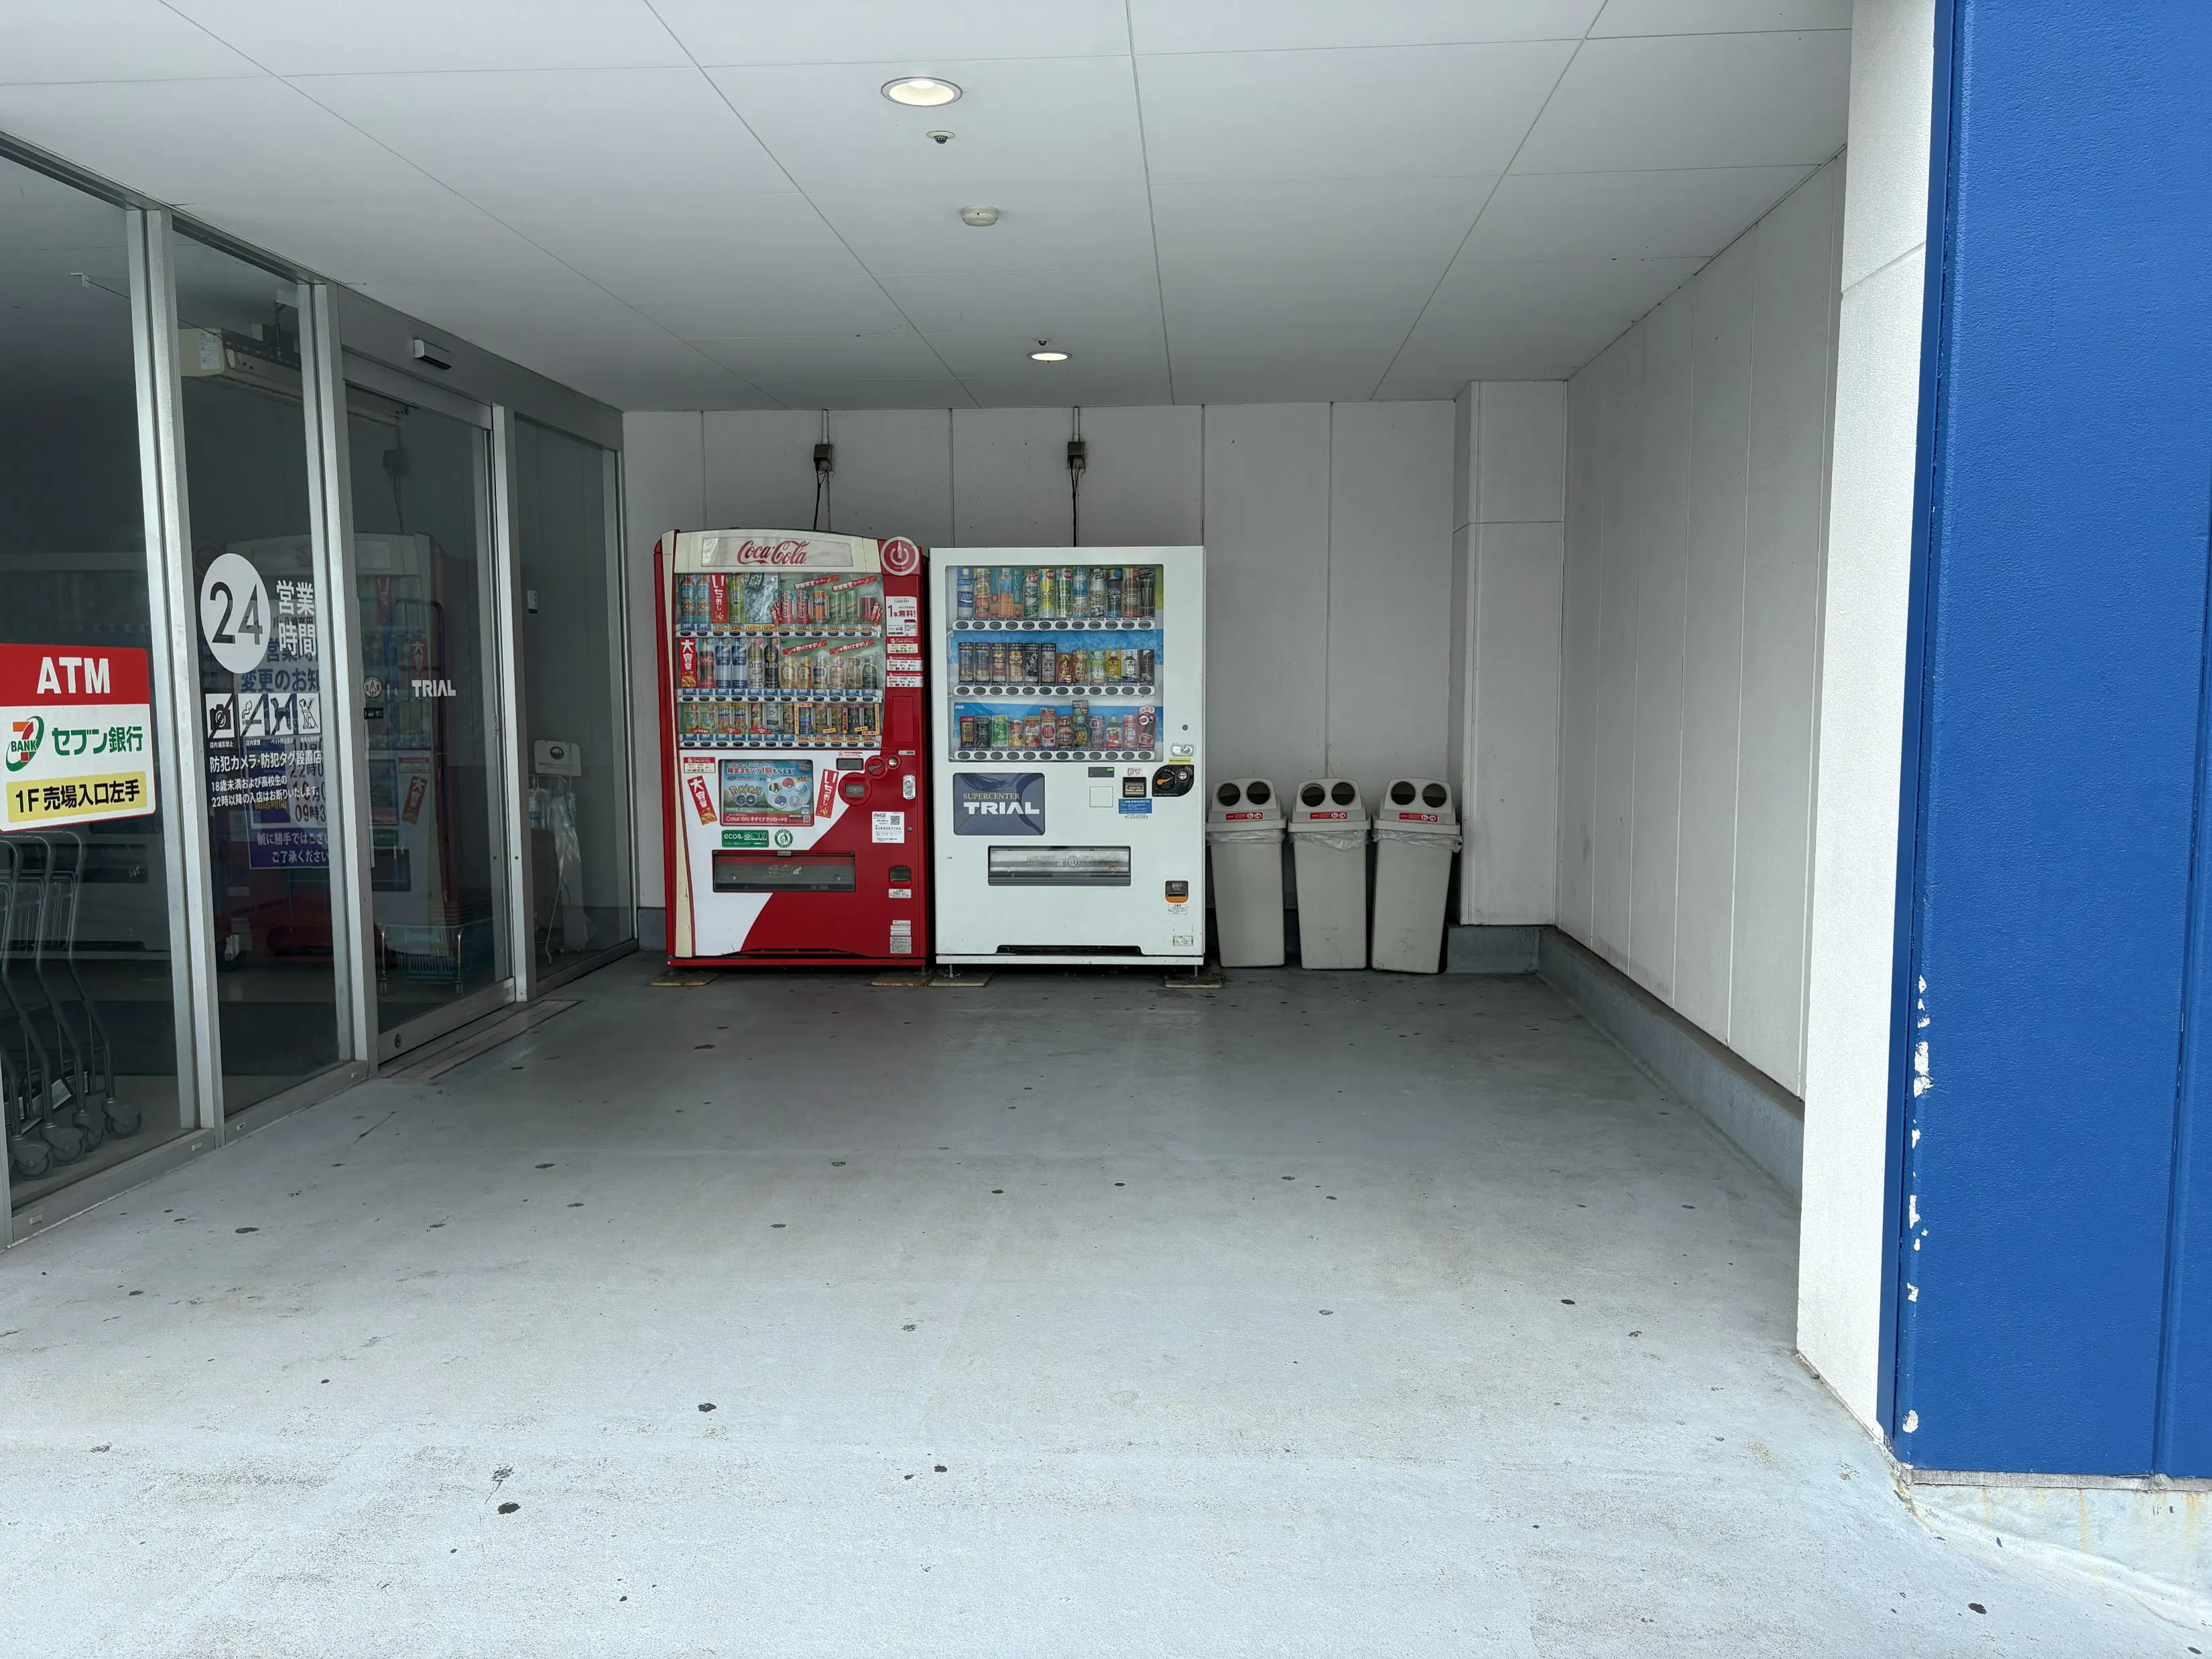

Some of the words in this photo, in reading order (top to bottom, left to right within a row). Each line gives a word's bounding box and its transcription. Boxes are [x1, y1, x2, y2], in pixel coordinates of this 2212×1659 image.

[737, 540, 811, 564] Coca-Cola
[276, 580, 314, 615] 営業
[210, 581, 263, 645] 24
[278, 621, 316, 656] 時間
[36, 656, 111, 694] ATM
[412, 680, 456, 698] TRIAL
[11, 740, 38, 752] BANK
[52, 726, 143, 756] セブン銀行
[210, 750, 321, 774] 防犯カメラ・防犯タグ設置店
[15, 788, 40, 813] 1F
[43, 778, 140, 811] 売場入口左手
[211, 774, 288, 792] 18歳未満および高校生の
[963, 802, 1040, 814] TRIAL
